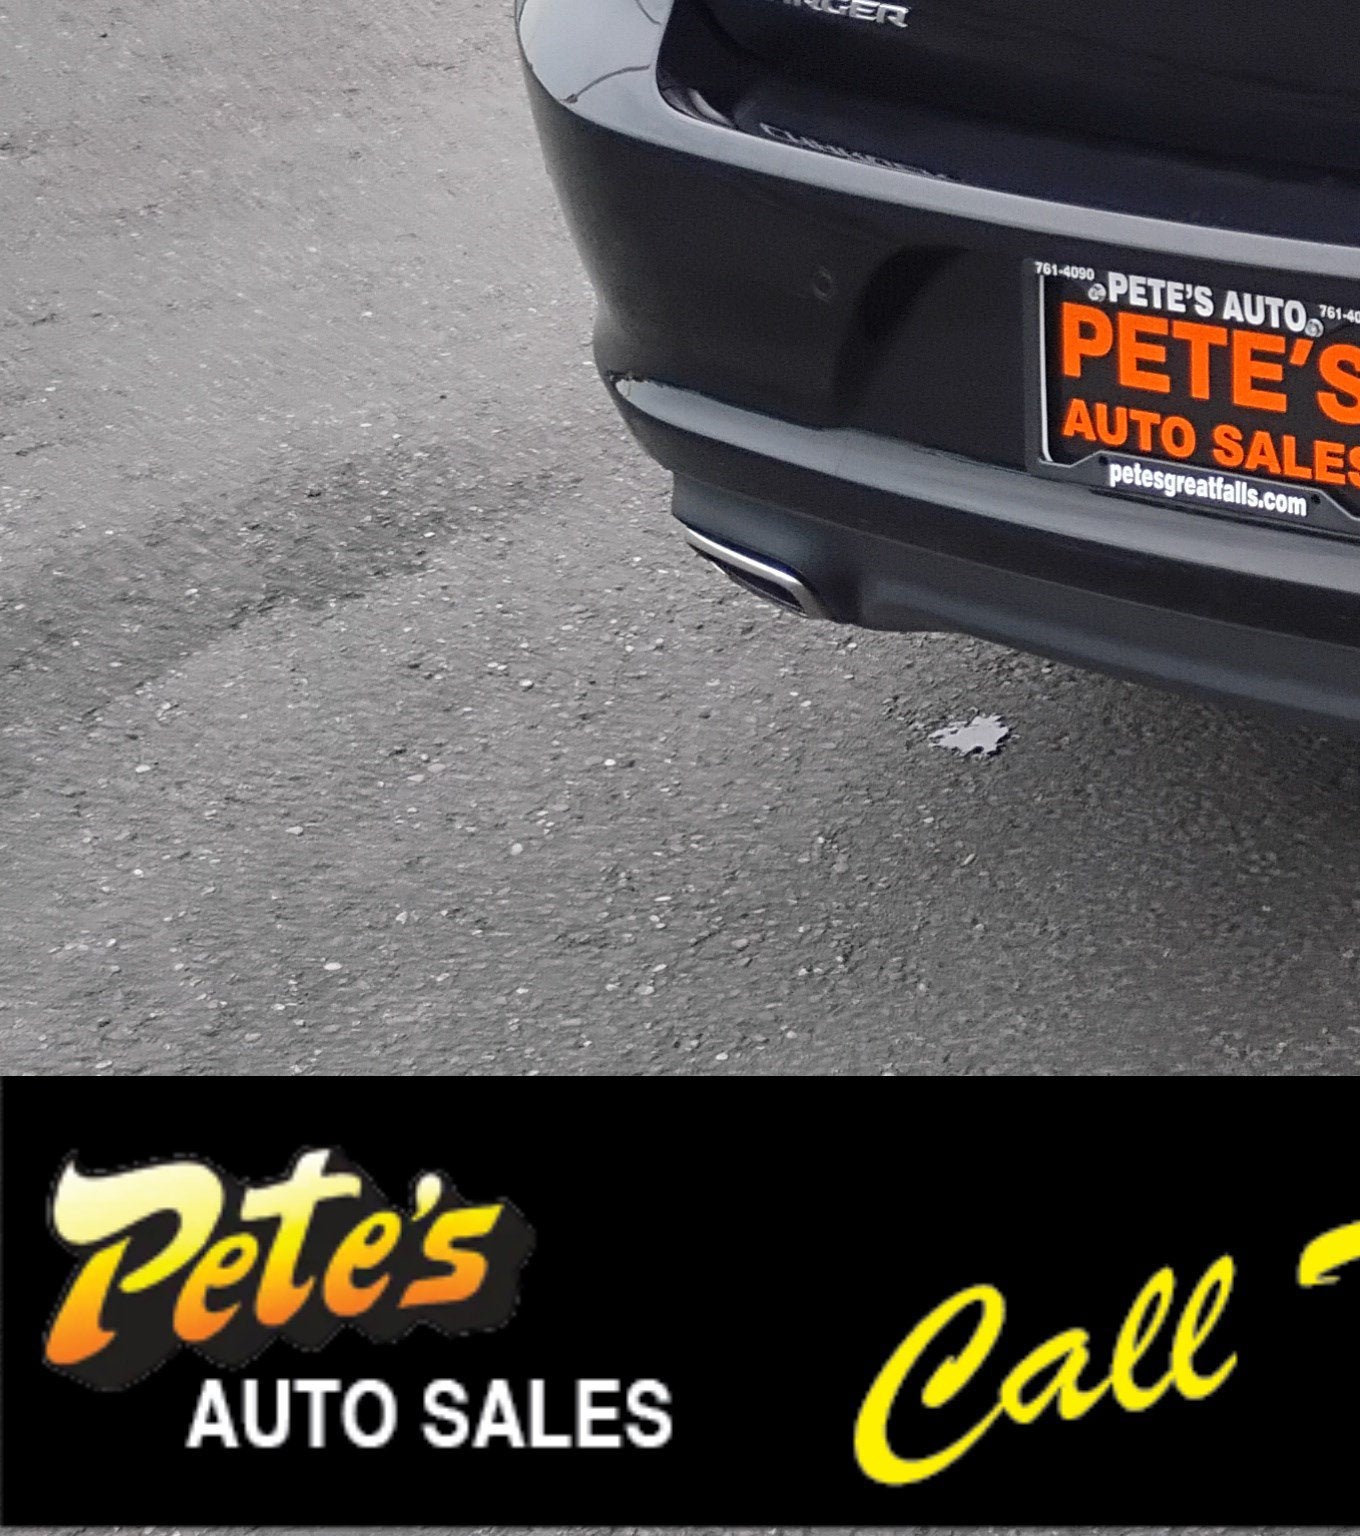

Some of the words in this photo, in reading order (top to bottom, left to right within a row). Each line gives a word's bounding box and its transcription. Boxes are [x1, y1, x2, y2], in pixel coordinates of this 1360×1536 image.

[1035, 262, 1095, 281] 761-4090
[1108, 271, 1214, 317] PETE'S
[1223, 291, 1306, 333] AUTO
[1063, 399, 1197, 459] AUTO
[1109, 463, 1307, 516] petesgreatfalls.com
